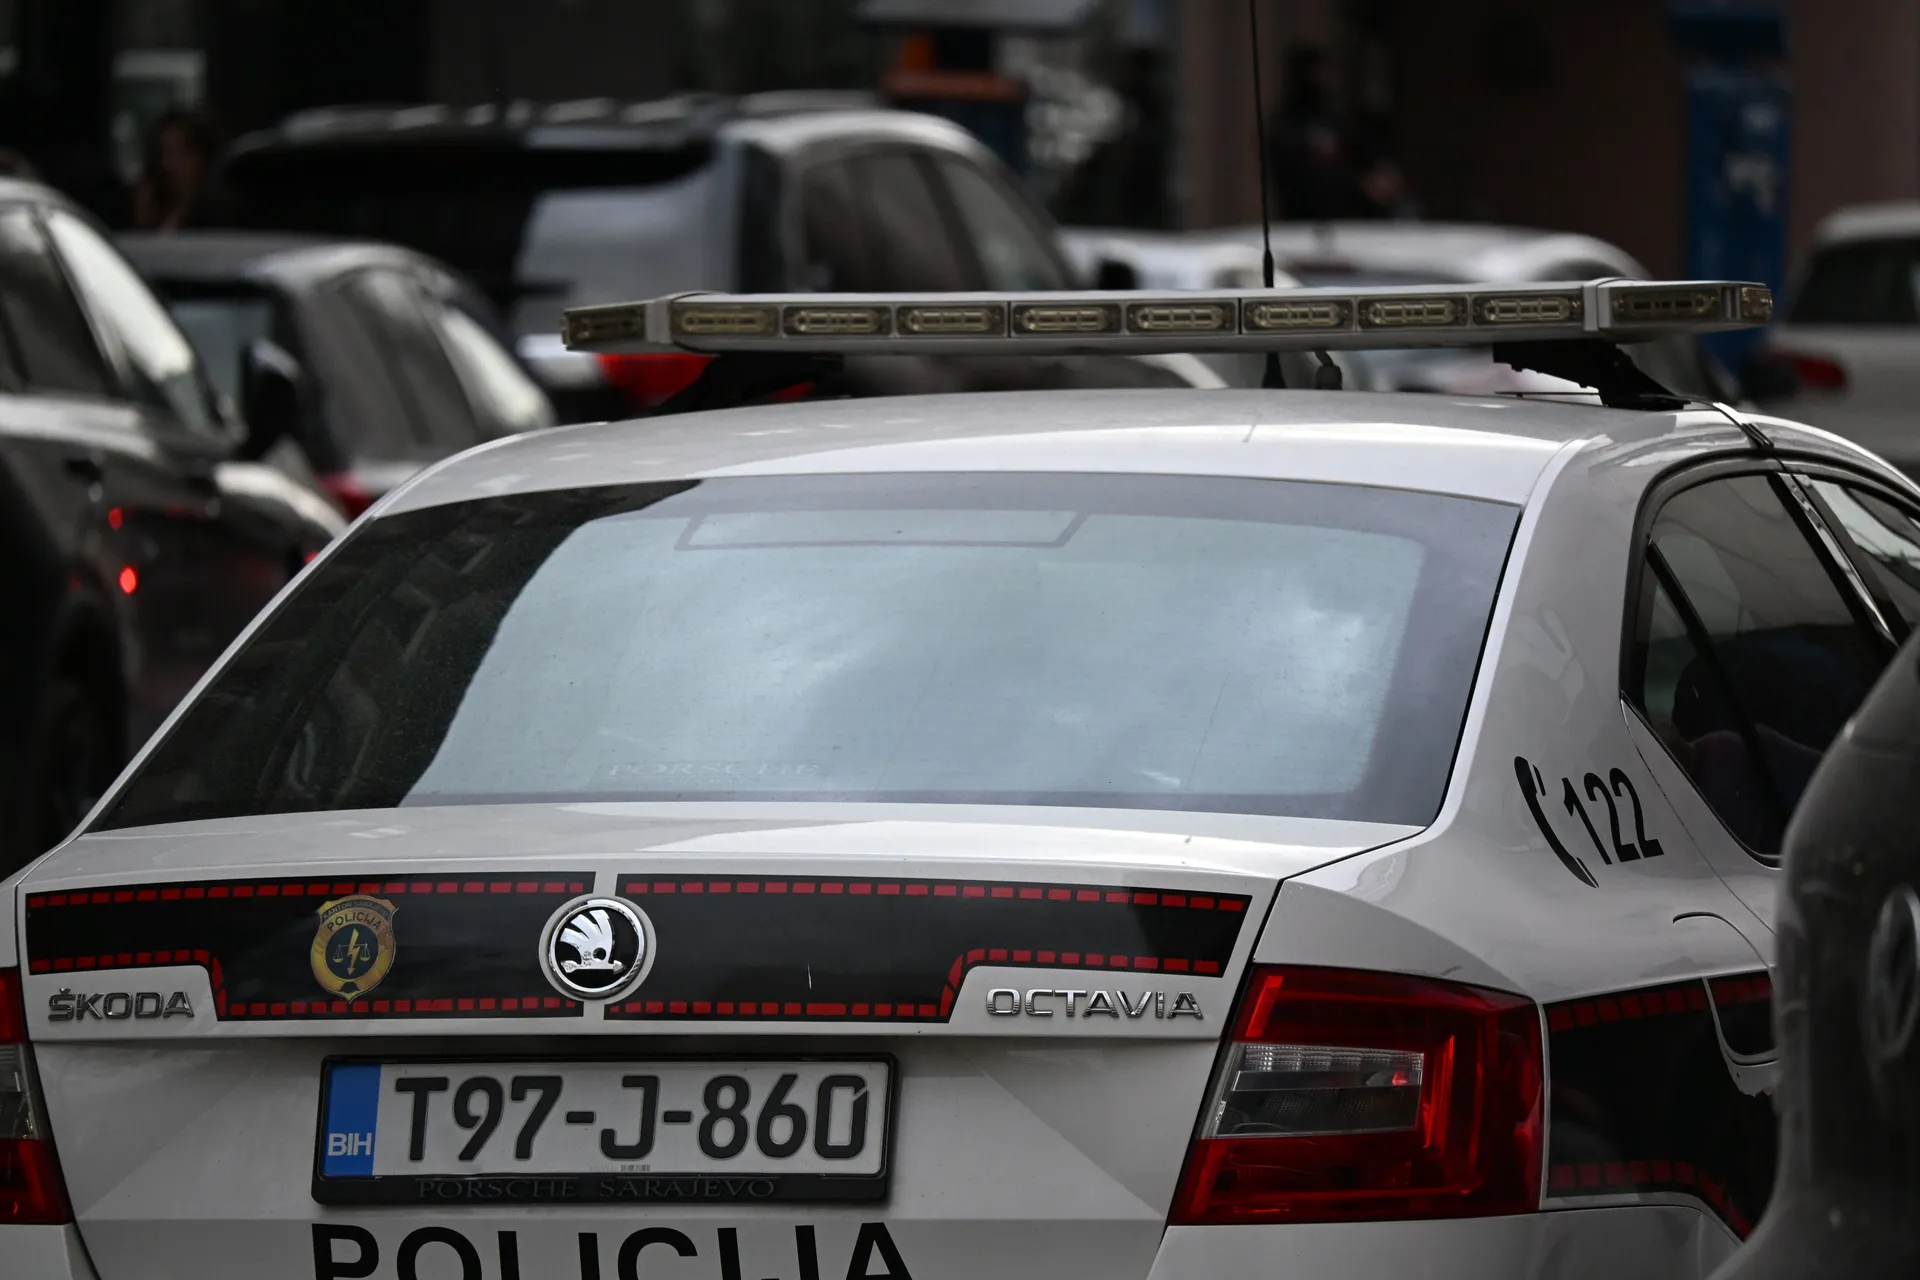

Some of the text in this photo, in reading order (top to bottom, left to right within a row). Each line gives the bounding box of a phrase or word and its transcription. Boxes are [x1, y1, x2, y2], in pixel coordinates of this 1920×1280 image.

[1561, 767, 1665, 866] 122
[327, 911, 381, 932] POLICIJA
[48, 987, 194, 1021] ŠKODA
[986, 988, 1204, 1020] OCTAVIA
[395, 1074, 869, 1161] T97-J-860
[327, 1132, 372, 1156] BIH
[419, 1178, 775, 1198] PORSCHE SARAJEVO
